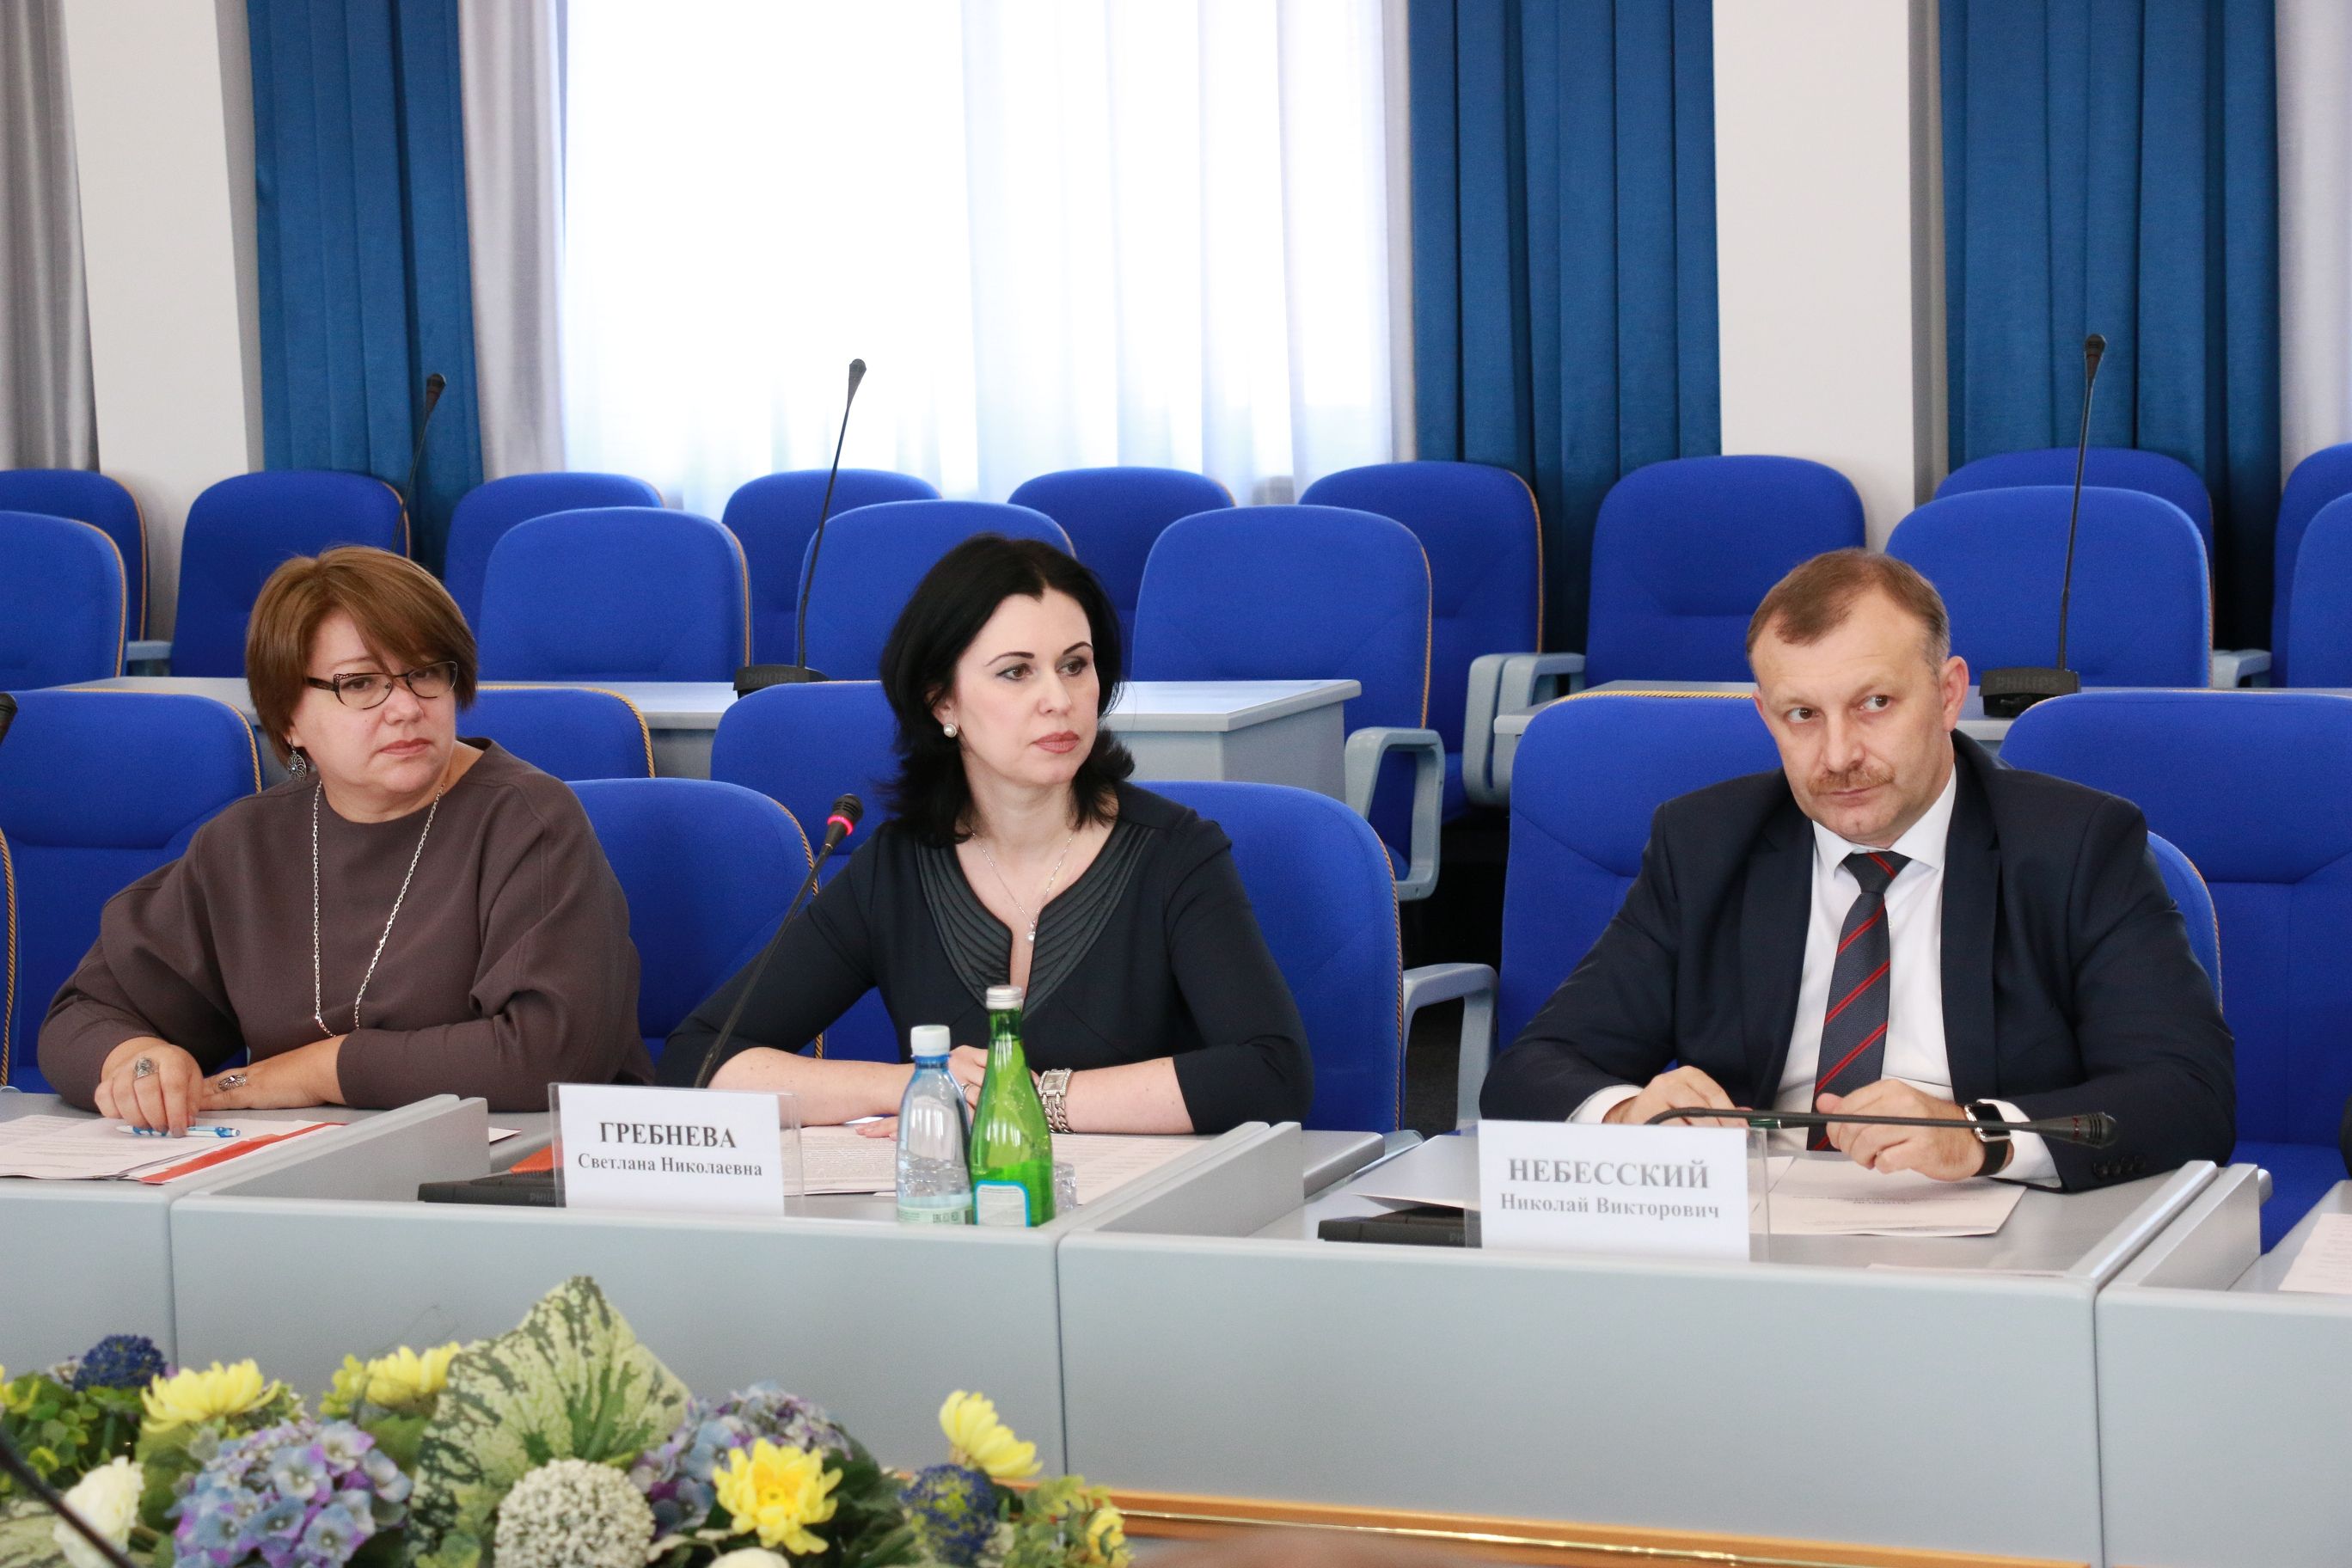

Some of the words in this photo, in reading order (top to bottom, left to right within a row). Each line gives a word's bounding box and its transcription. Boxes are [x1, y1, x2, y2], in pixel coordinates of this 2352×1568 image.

[744, 672, 796, 684] PHILIPS
[1995, 676, 2059, 689] PHILIPS
[599, 1122, 737, 1148] ГРЕБНЕВА
[578, 1153, 656, 1172] Светлана
[660, 1157, 763, 1177] Николаевна
[1509, 1158, 1709, 1189] НЕБЕССКИЙ
[1500, 1192, 1589, 1213] Николай
[1596, 1197, 1719, 1220] Викторович
